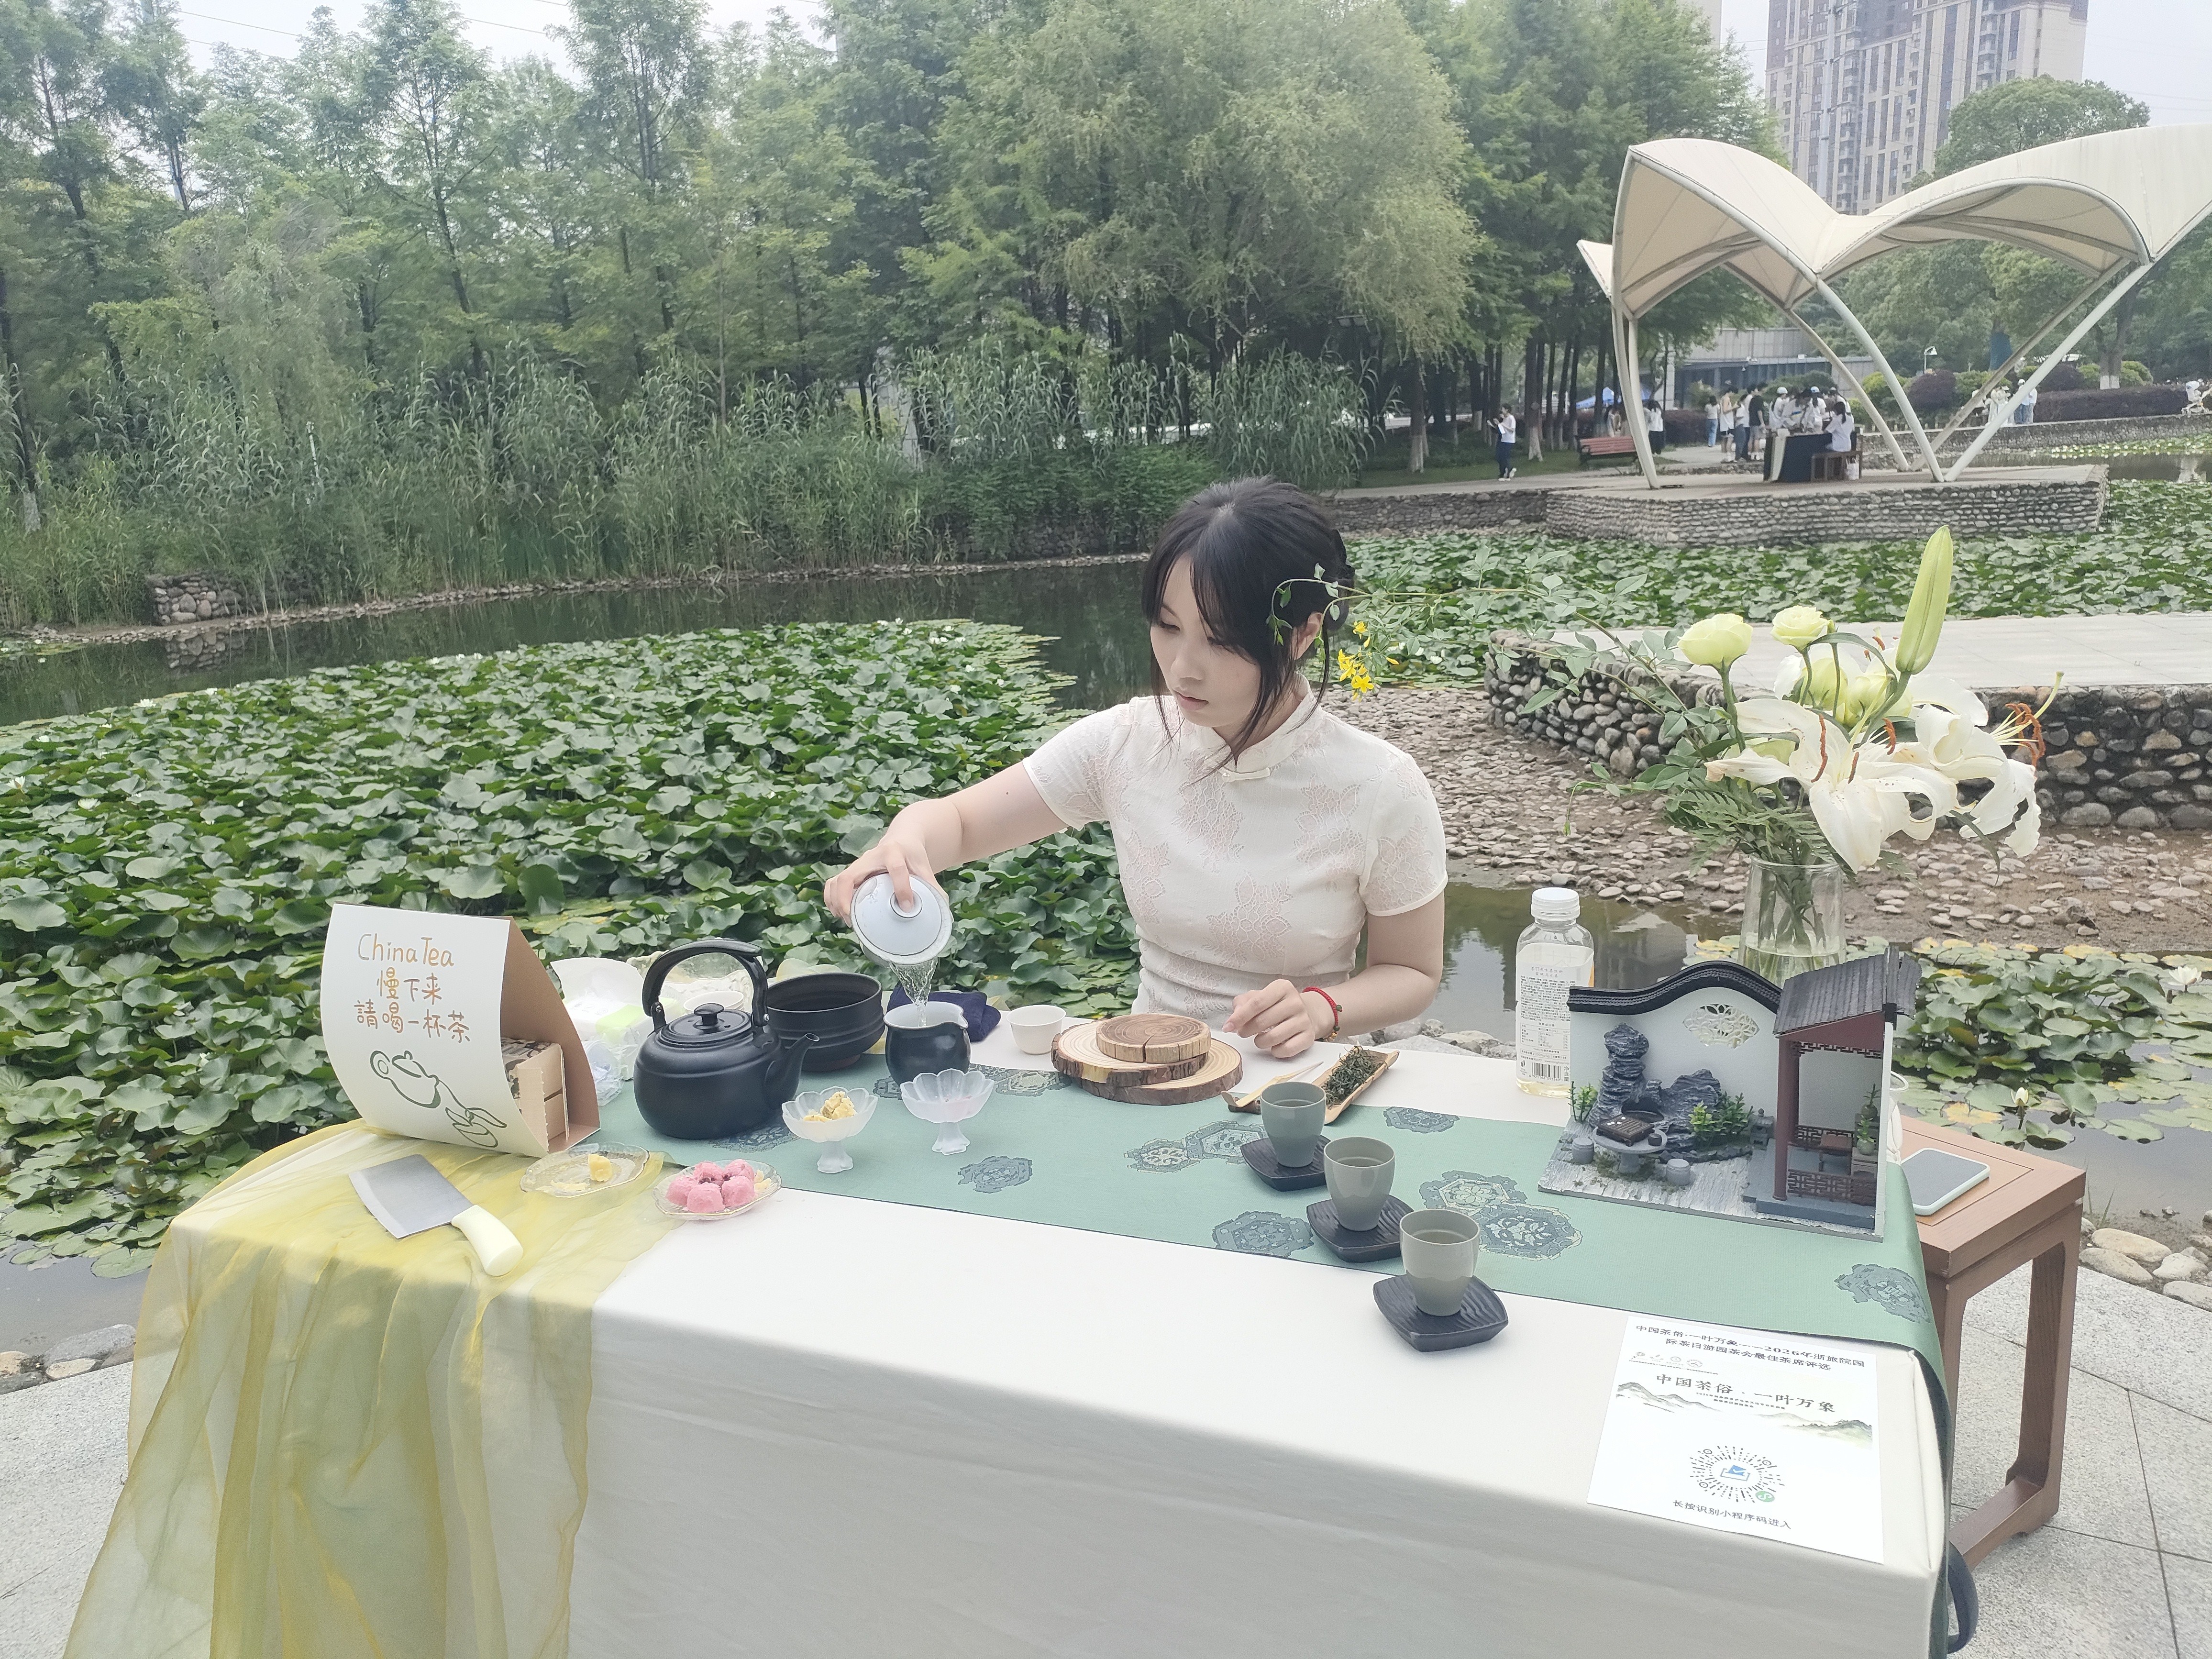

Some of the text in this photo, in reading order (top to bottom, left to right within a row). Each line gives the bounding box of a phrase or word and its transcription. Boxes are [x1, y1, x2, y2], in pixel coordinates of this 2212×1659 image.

[376, 966, 442, 1005] 慢下来
[354, 998, 470, 1043] 請喝一杯茶
[1666, 1338, 1831, 1371] 际茶日游园茶会最佳茶席评选
[1673, 1500, 1792, 1529] 长按识别小程序码进入
